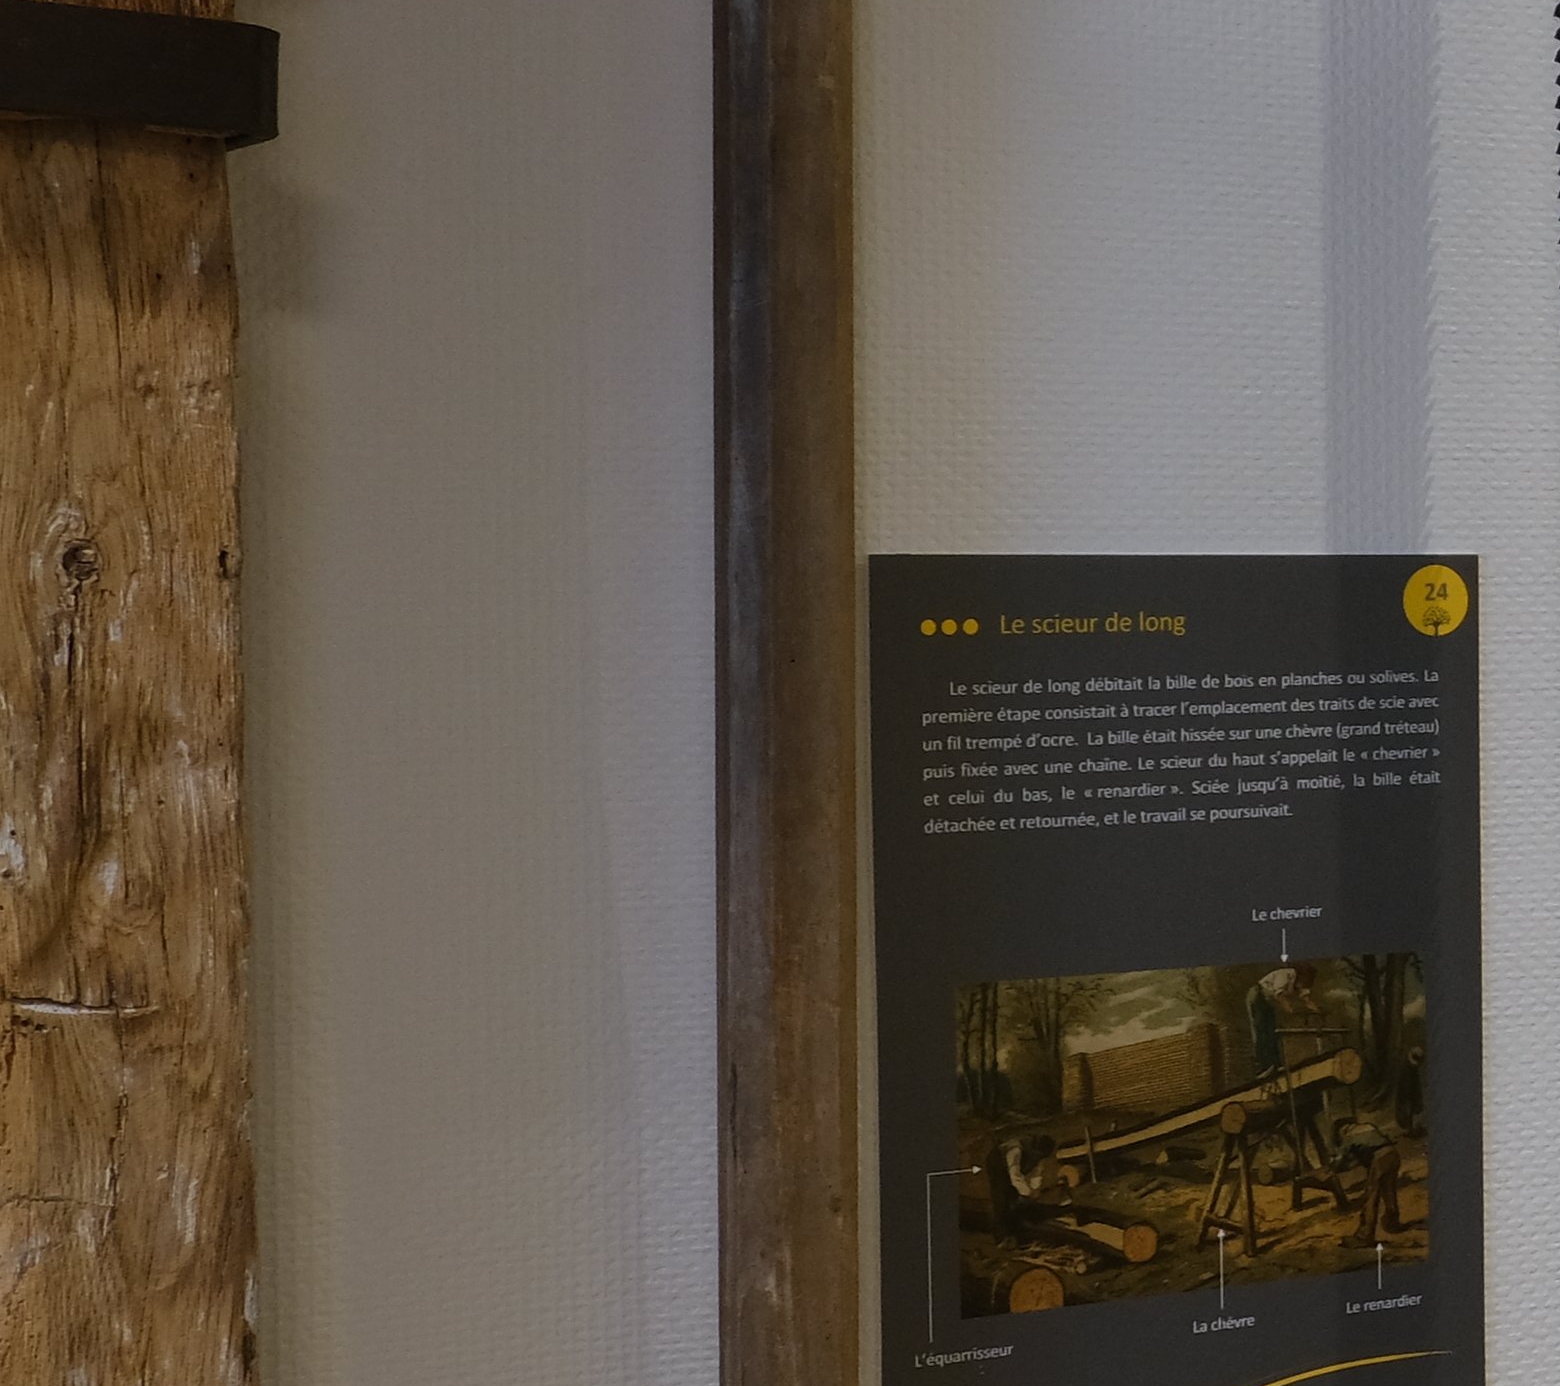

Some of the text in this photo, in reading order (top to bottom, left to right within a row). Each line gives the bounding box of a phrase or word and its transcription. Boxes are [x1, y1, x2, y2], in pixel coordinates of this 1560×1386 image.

[1424, 583, 1448, 602] 24
[1001, 611, 1185, 636] Le scieur de long
[950, 669, 1438, 696] Le scieur de long débitait la bille de bois en planches ou solives. La
[923, 708, 992, 726] première
[997, 707, 1040, 723] étape
[1045, 705, 1116, 720] consistait
[1120, 703, 1128, 718] à
[1133, 704, 1176, 716] tracer
[1291, 697, 1315, 711] des
[1319, 697, 1354, 710] traits
[1358, 697, 1375, 709] de
[1380, 696, 1405, 709] scie
[1409, 697, 1438, 708] avec
[923, 740, 942, 751] un
[947, 736, 960, 749] fil
[966, 734, 1022, 752] trempé
[1088, 732, 1103, 745] La
[1108, 730, 1139, 744] bille
[1143, 729, 1176, 743] était
[1181, 727, 1225, 742] hissée
[1229, 730, 1251, 740] sur
[1256, 729, 1282, 739] une
[1337, 722, 1380, 739] (grand
[1385, 719, 1439, 736] tréteau)
[924, 764, 954, 781] puis
[961, 762, 997, 776] fixée
[1004, 764, 1038, 775] avec
[1045, 763, 1072, 774] une
[1138, 757, 1154, 770] Le
[1160, 755, 1202, 769] scieur
[1208, 753, 1227, 767] du
[1233, 752, 1264, 766] haut
[1343, 748, 1355, 761] le
[1373, 745, 1427, 760] chevrier
[924, 795, 939, 806] et
[949, 790, 984, 804] celui
[994, 789, 1013, 802] du
[1023, 787, 1052, 803] bas,
[1062, 786, 1075, 800] le
[1098, 783, 1166, 798] renardier
[1192, 779, 1229, 795] Sciée
[1354, 774, 1364, 786] la
[1373, 772, 1401, 785] bille
[1410, 770, 1440, 784] était
[924, 803, 1292, 833] détachée et retournée, et le travail se poursuivait.
[1252, 905, 1321, 921] Le chevrier
[1347, 1294, 1422, 1313] Le renardier
[1193, 1320, 1207, 1333] La
